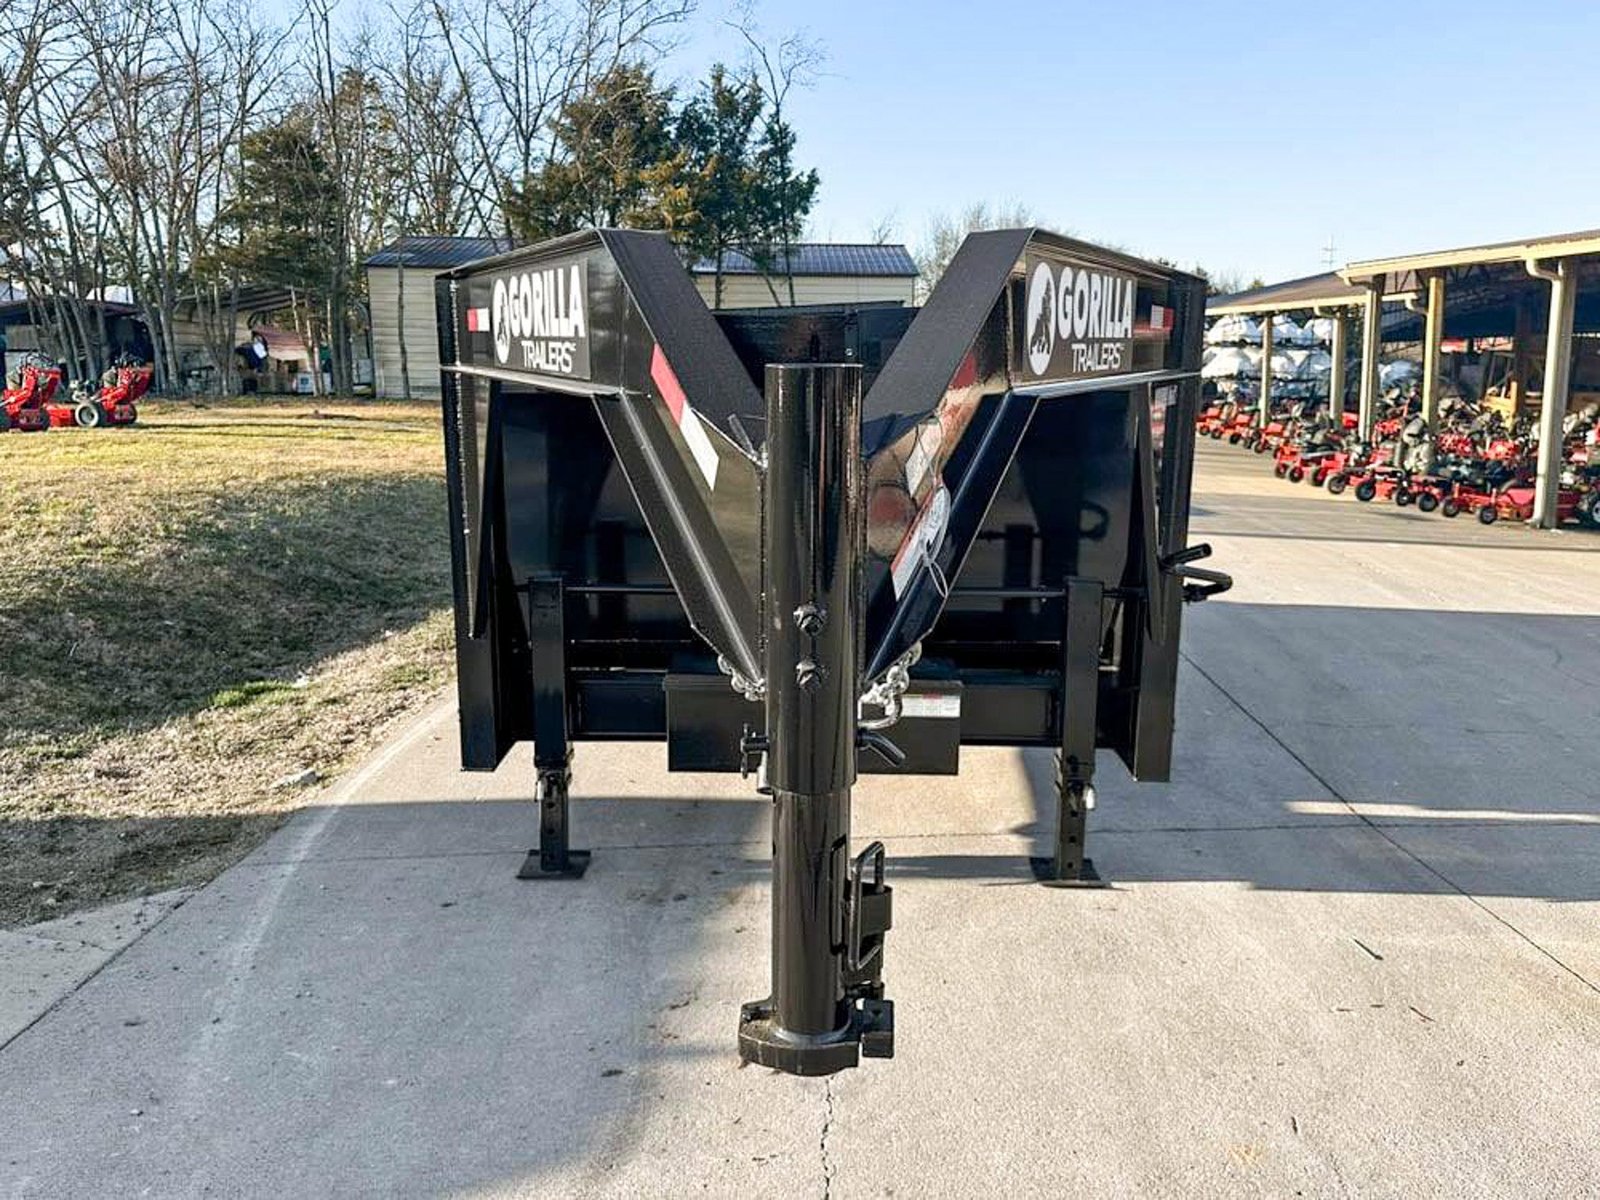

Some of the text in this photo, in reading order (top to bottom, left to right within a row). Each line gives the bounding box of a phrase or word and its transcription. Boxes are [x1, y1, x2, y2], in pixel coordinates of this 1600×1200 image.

[508, 265, 585, 338] GORILLA
[1058, 266, 1132, 339] GORILLA
[521, 340, 574, 373] TRAILERS
[1072, 343, 1122, 373] TRAILERS
